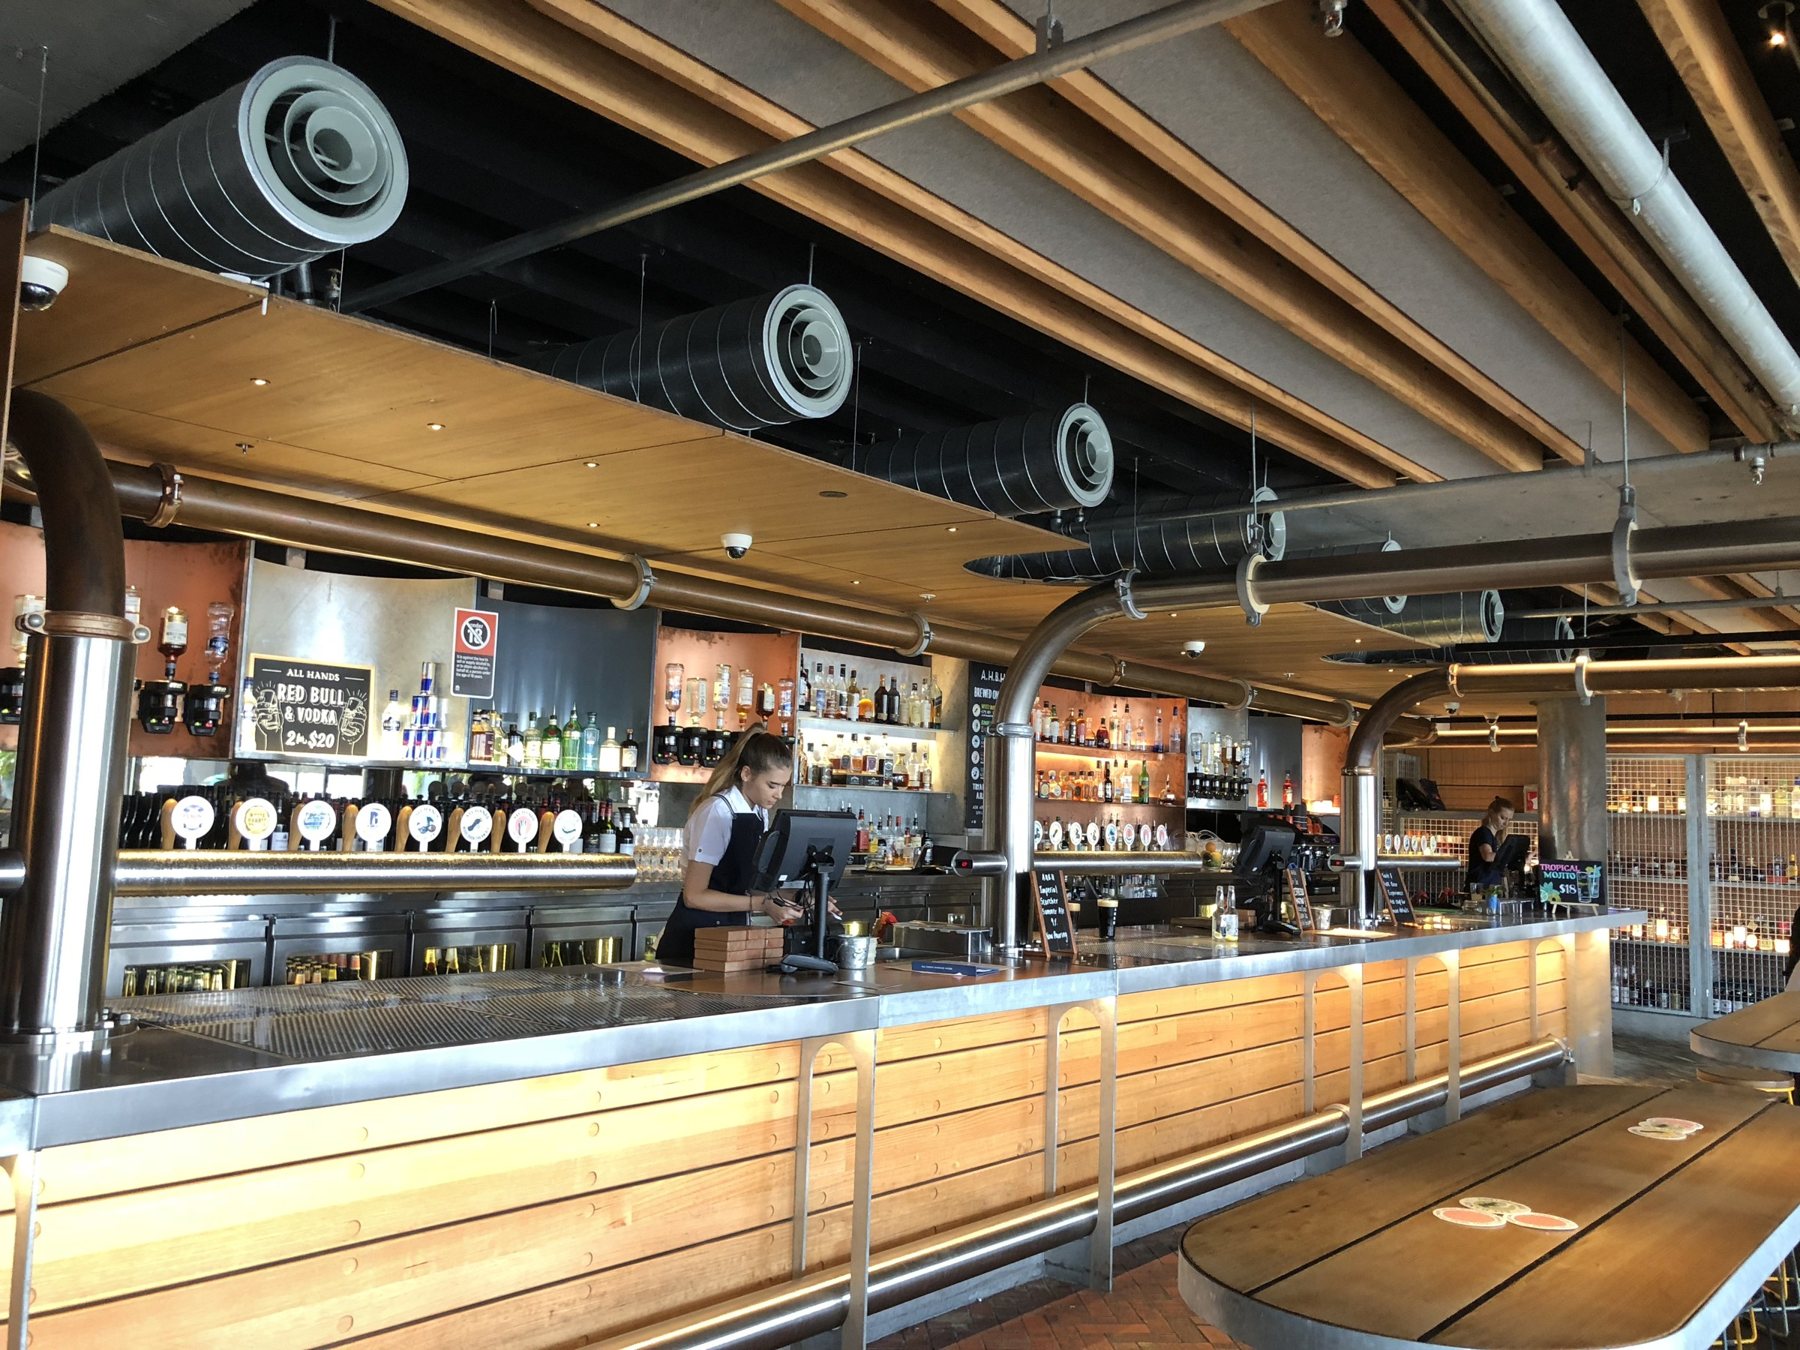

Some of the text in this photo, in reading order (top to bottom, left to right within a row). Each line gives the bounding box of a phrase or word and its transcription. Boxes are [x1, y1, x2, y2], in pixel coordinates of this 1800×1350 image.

[467, 628, 483, 644] 18
[286, 668, 340, 681] ALL HANDS
[277, 683, 345, 707] RED BULL
[974, 686, 991, 699] BREWED
[285, 706, 338, 725] & VODKA
[285, 730, 296, 746] 2
[308, 730, 335, 749] $20
[1540, 863, 1580, 872] TROPICAL
[1543, 871, 1576, 879] MOJITO
[1039, 885, 1058, 896] Imperial
[1559, 883, 1577, 894] $18
